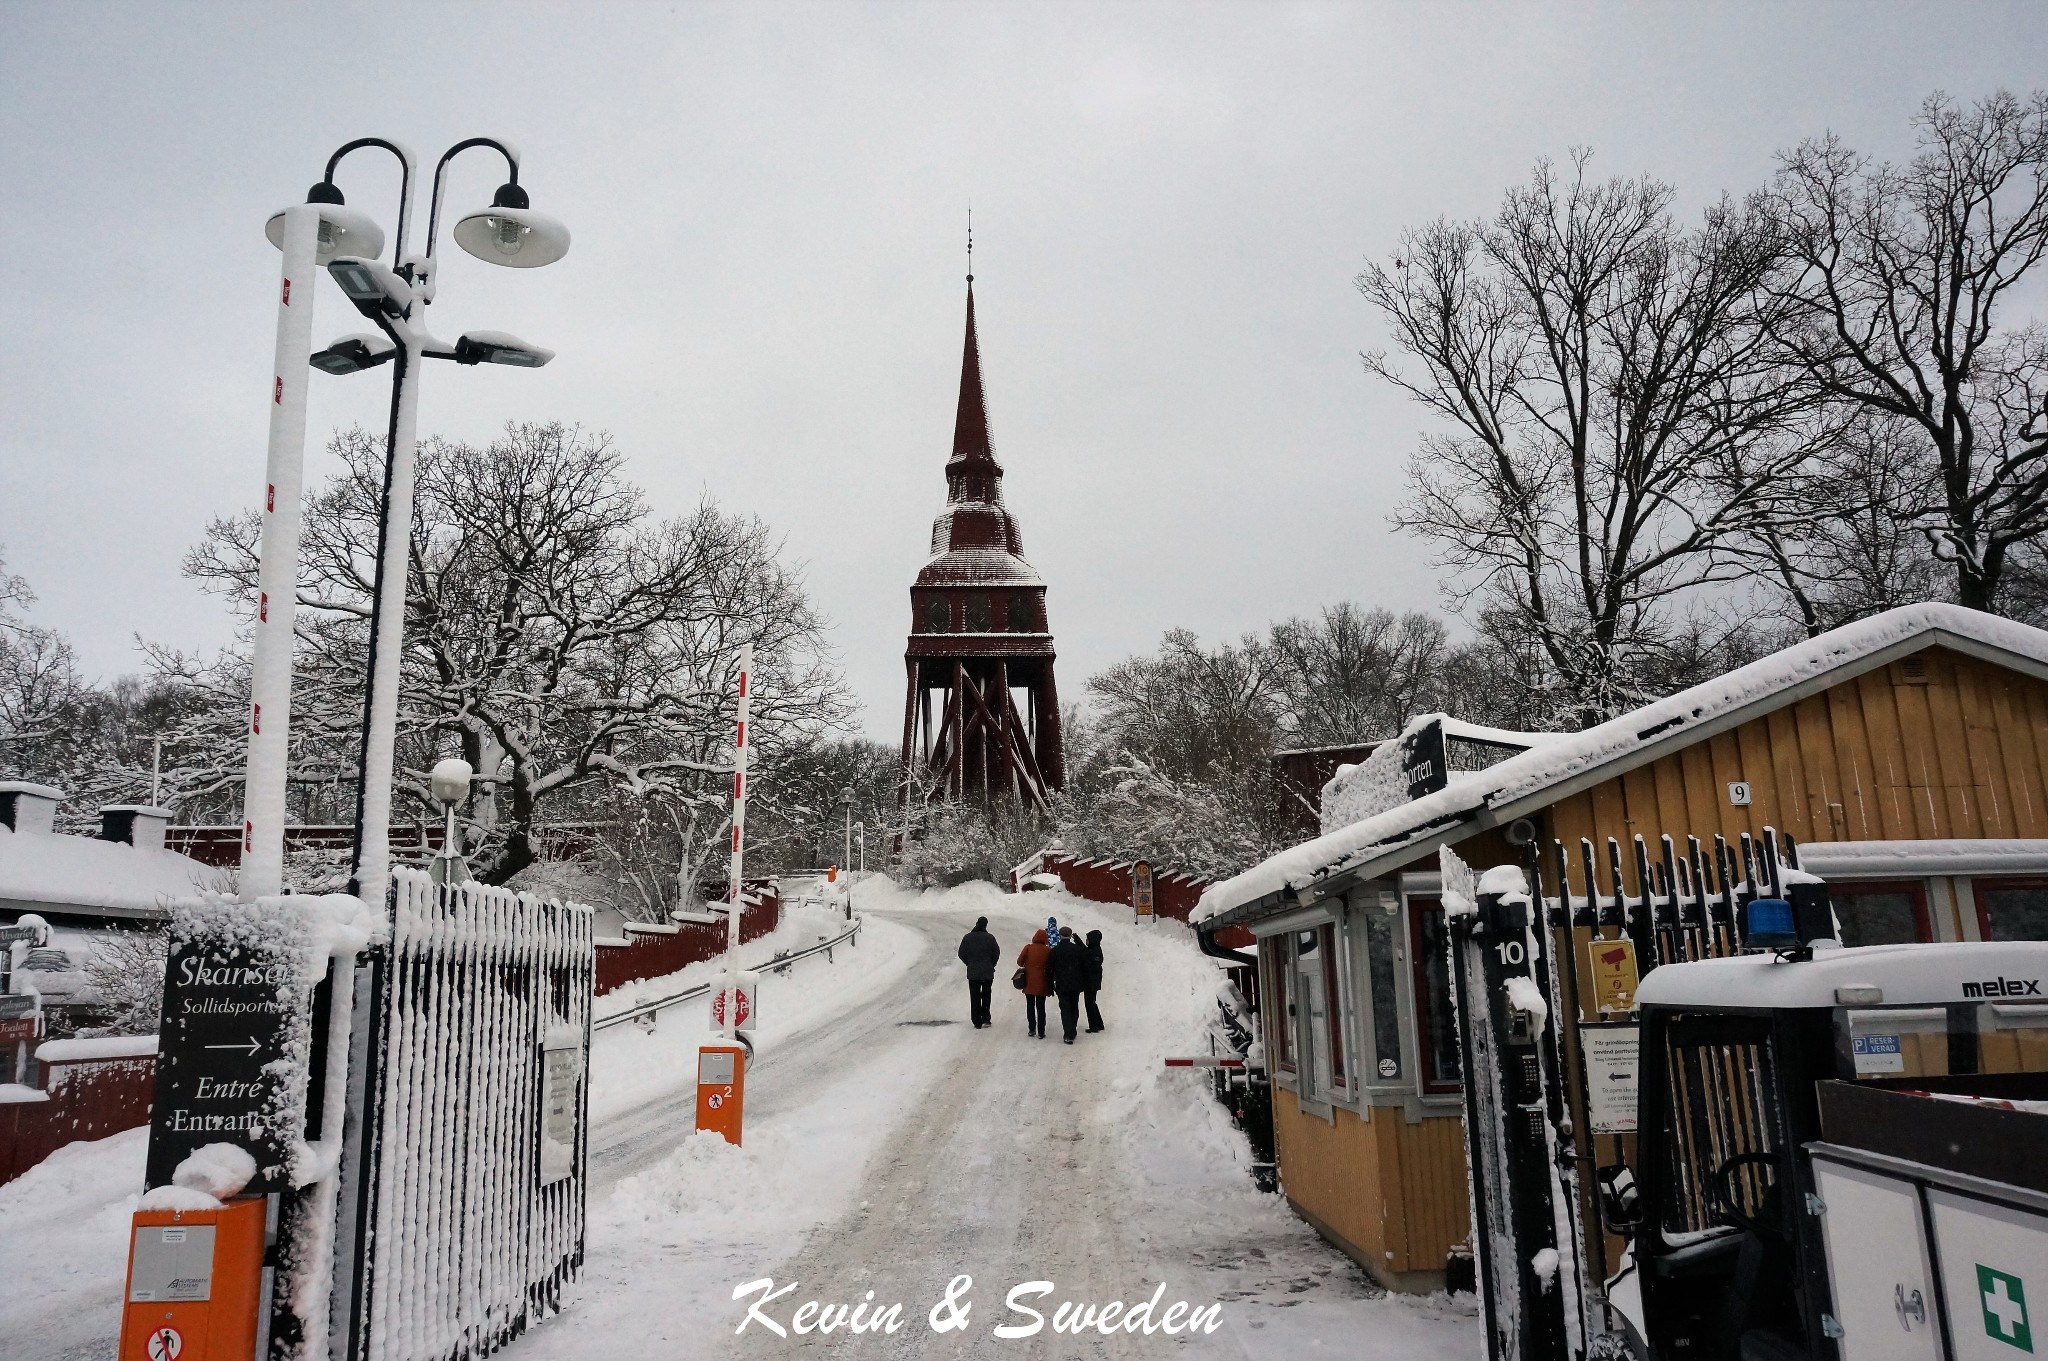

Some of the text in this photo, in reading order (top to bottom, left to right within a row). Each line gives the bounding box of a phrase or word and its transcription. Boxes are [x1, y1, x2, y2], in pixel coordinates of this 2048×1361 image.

[1735, 785, 1745, 802] 9
[1494, 941, 1524, 965] 10
[1961, 976, 2042, 998] melex
[1855, 1039, 1863, 1051] P
[194, 1076, 264, 1099] Entré
[723, 1085, 733, 1098] 2
[171, 1109, 278, 1131] Entrance
